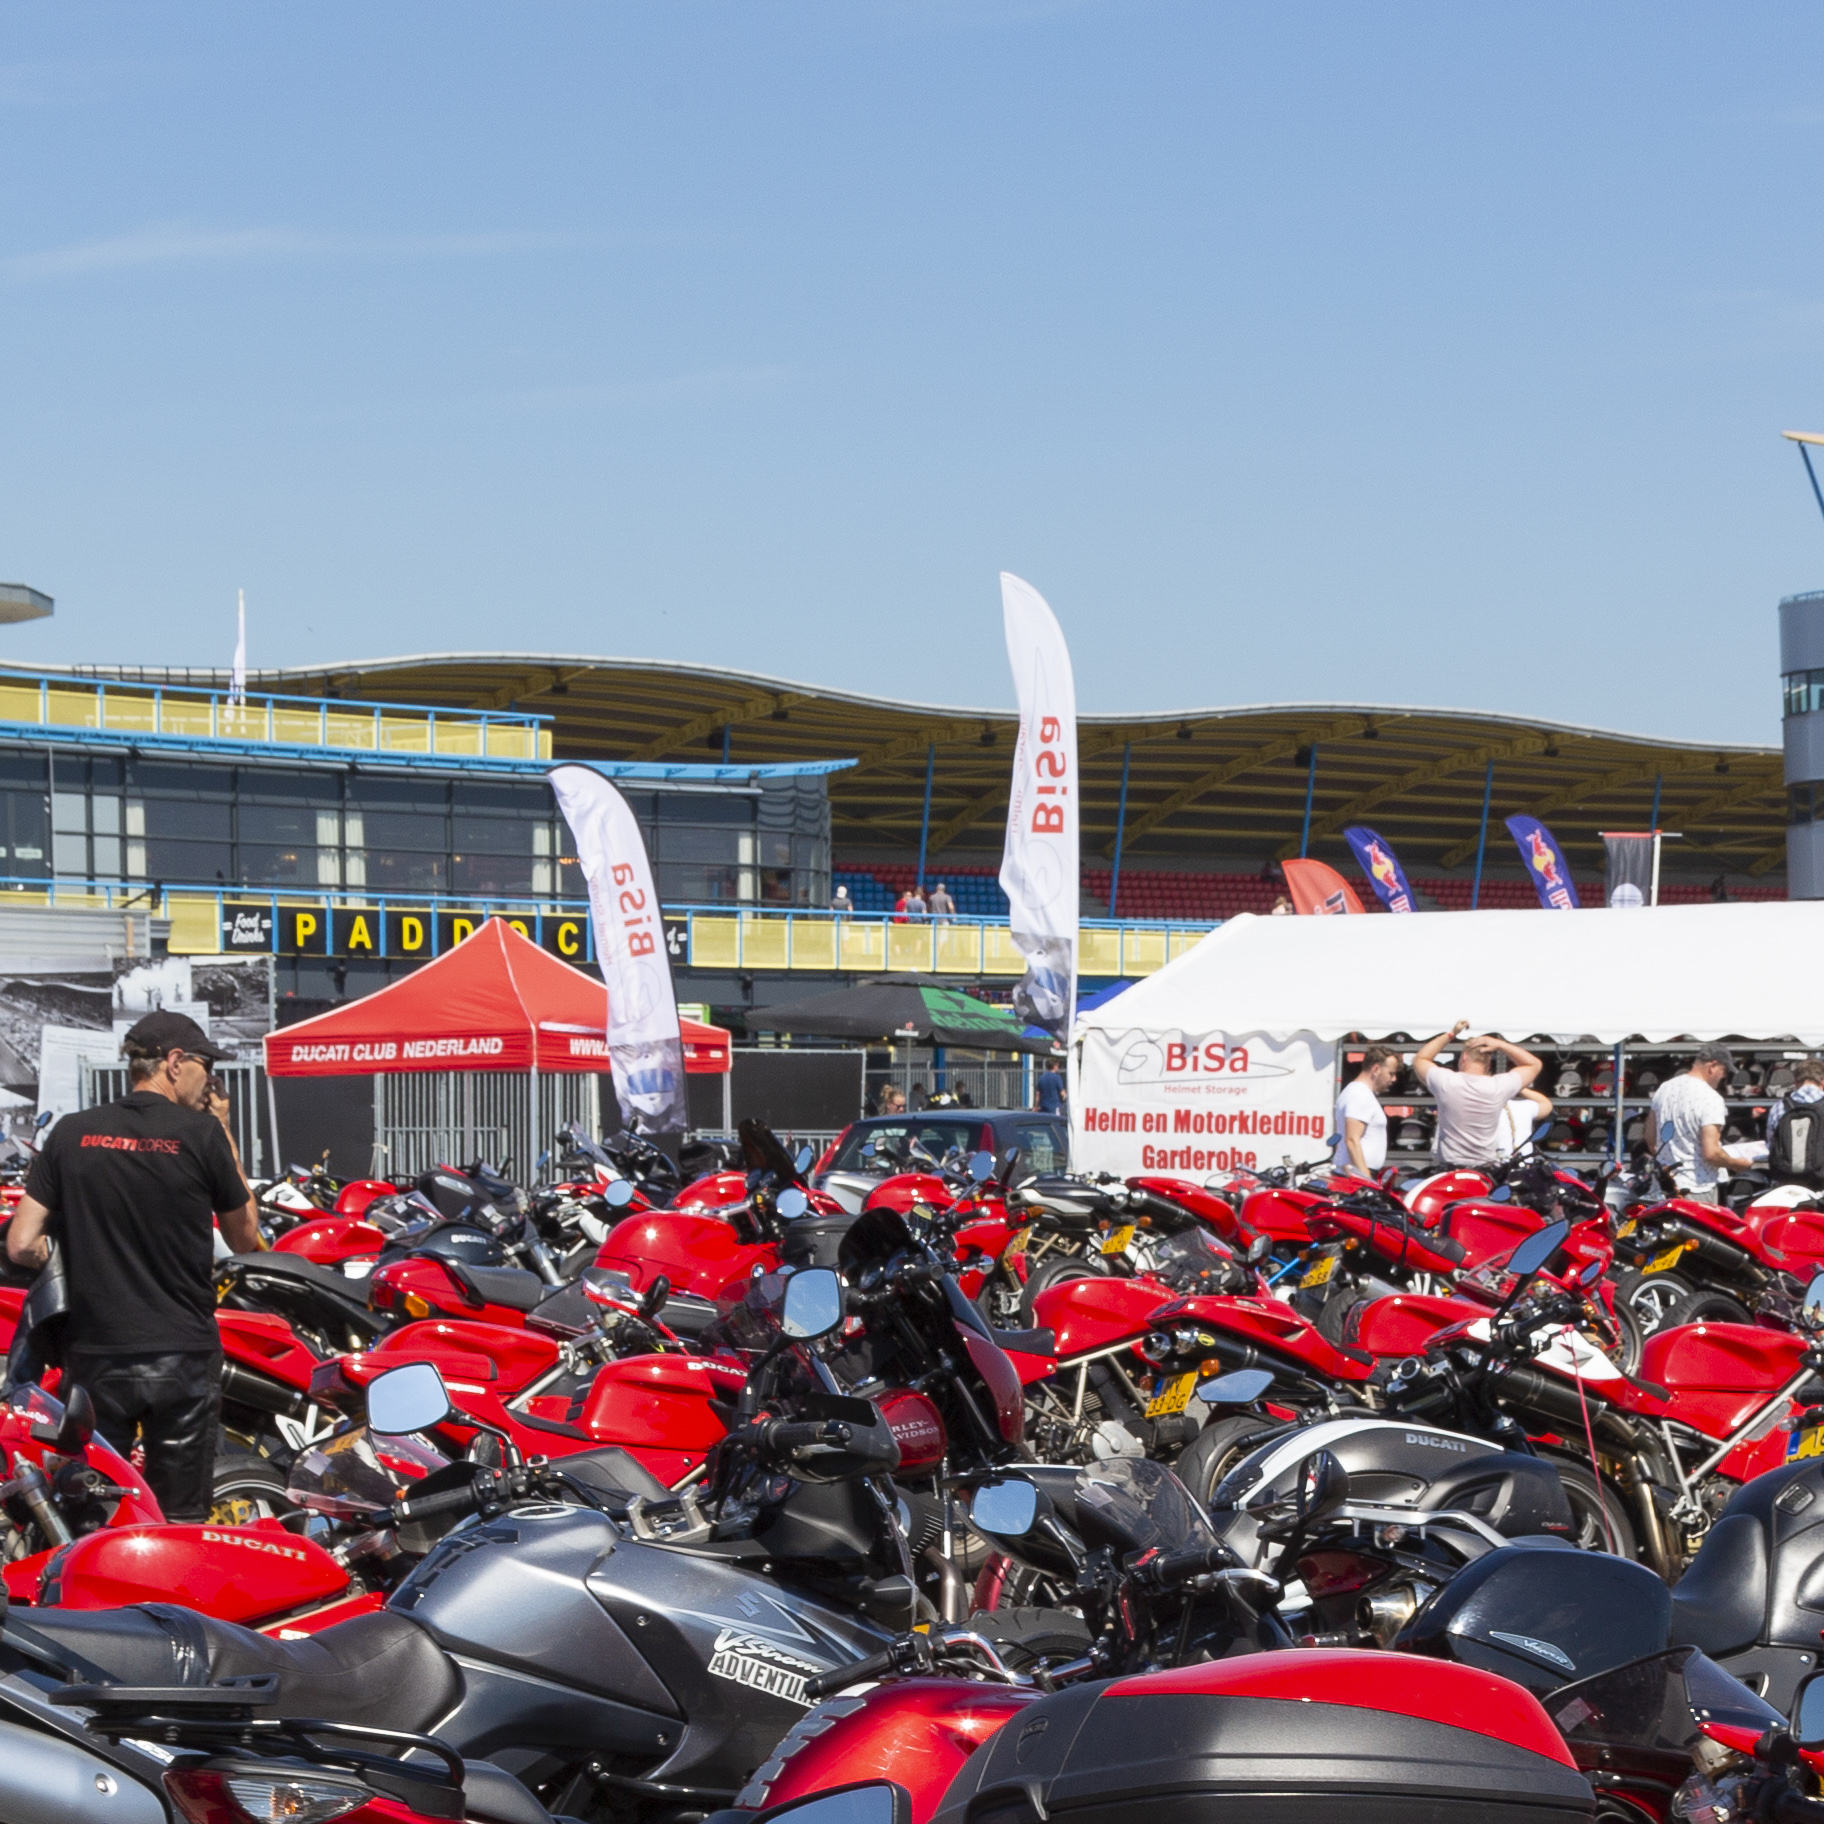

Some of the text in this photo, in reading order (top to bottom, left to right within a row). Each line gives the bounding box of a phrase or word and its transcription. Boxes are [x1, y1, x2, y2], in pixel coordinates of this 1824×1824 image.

[234, 912, 260, 928] Food
[291, 1037, 503, 1063] DUCATI CLUB NEDERLAND
[1165, 1042, 1250, 1073] BiSa
[1164, 1084, 1248, 1099] Helmet Storage
[1084, 1107, 1325, 1140] Helm en Motorkleding
[80, 1133, 181, 1155] DUCATI CORSE
[1405, 1433, 1466, 1453] DUCATI
[201, 1530, 306, 1561] DUCATI
